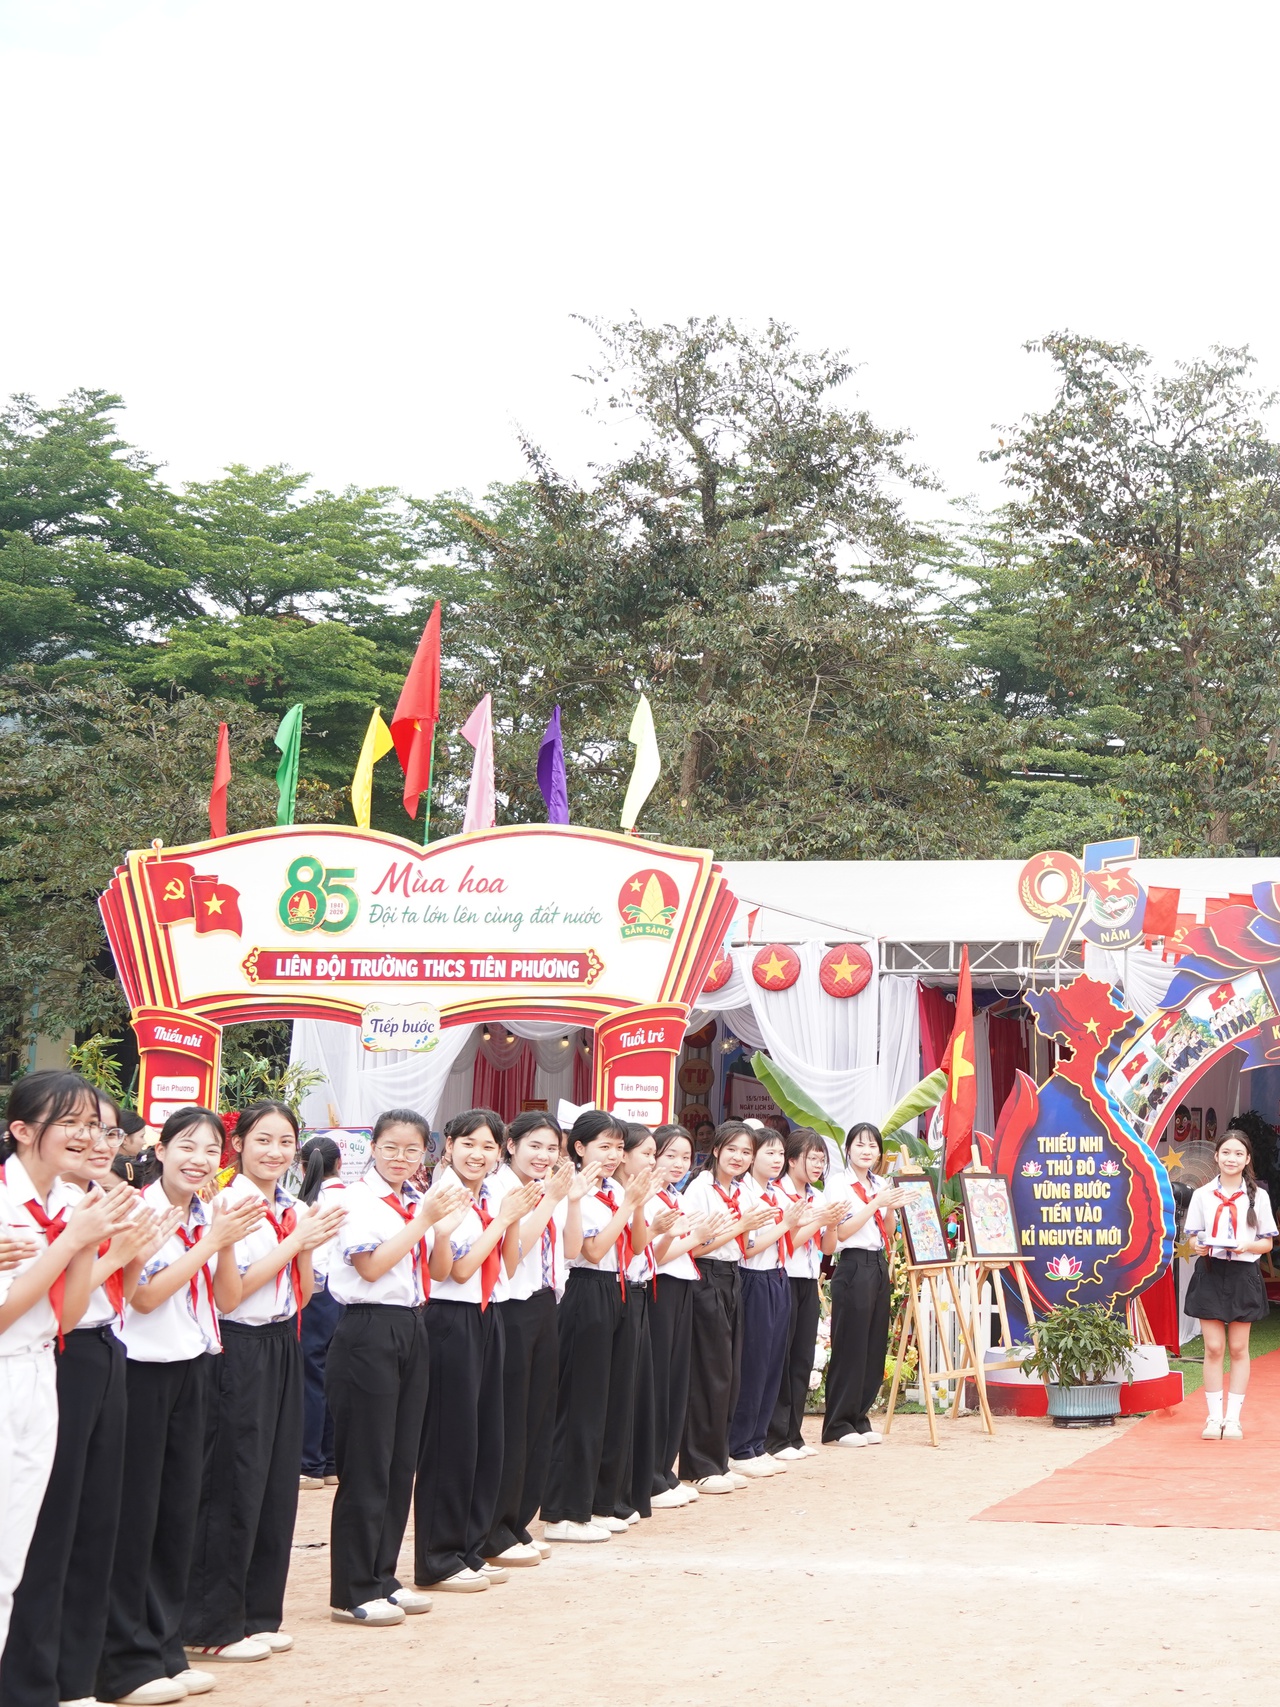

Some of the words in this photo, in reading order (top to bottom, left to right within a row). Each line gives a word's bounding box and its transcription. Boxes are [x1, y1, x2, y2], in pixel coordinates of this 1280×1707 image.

[371, 862, 449, 898] Mùa
[457, 865, 508, 893] hoa
[279, 853, 360, 936] 85
[369, 904, 398, 928] Đội
[401, 906, 420, 923] ta
[423, 905, 449, 923] lớn
[453, 905, 479, 923] lên
[484, 906, 524, 932] cùng
[529, 901, 561, 924] đất
[563, 906, 603, 924] nước
[645, 925, 670, 937] SÀNG
[1100, 928, 1131, 943] NĂM
[275, 954, 312, 977] LIÊN
[315, 954, 346, 981] ĐỘI
[350, 954, 419, 978] TRƯỜNG
[422, 959, 466, 979] THCS
[470, 955, 506, 979] TIÊN
[511, 958, 580, 979] PHƯƠNG
[153, 1026, 183, 1044] Thiếu
[183, 1035, 203, 1048] nhi
[370, 1016, 402, 1037] Tiếp
[402, 1018, 435, 1034] bước
[619, 1027, 646, 1048] Tuổi
[647, 1027, 666, 1044] trẻ
[1037, 1132, 1076, 1153] THIẾU
[1079, 1136, 1104, 1152] NHI
[1046, 1155, 1073, 1176] THỦ
[1076, 1157, 1095, 1176] ĐÔ
[1033, 1180, 1071, 1199] VỮNG
[1073, 1180, 1111, 1199] BƯỚC
[1040, 1202, 1071, 1223] TIẾN
[1074, 1203, 1102, 1223] VÀO
[1021, 1225, 1036, 1246] KỈ
[1038, 1226, 1093, 1246] NGUYÊN
[1095, 1226, 1122, 1246] MỚI
